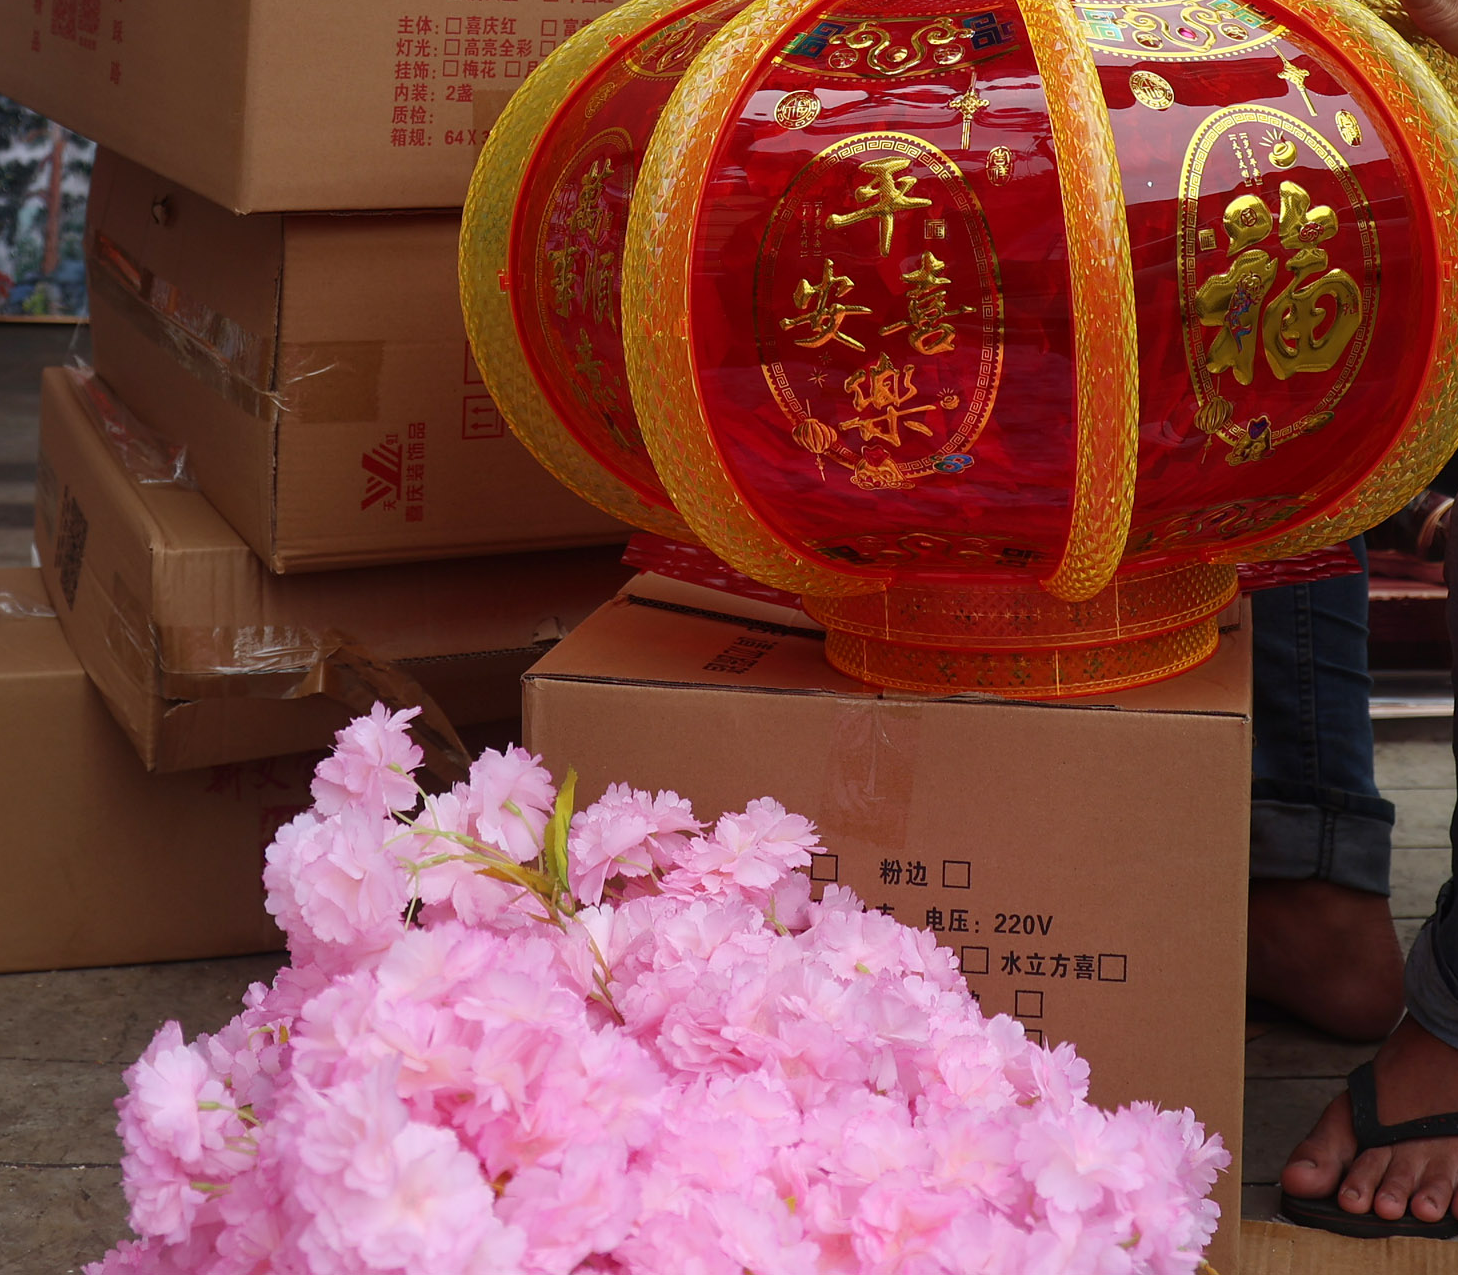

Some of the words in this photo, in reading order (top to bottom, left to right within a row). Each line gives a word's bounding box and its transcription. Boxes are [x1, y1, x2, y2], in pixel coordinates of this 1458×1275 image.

[465, 17, 517, 35] 喜庆红
[464, 39, 533, 58] 高亮全彩
[462, 60, 496, 79] 梅花
[825, 156, 932, 257] 平
[1195, 180, 1362, 385] 福
[779, 258, 873, 352] 安
[878, 251, 977, 355] 喜
[839, 352, 936, 447] 樂
[879, 858, 928, 887] 粉边
[994, 913, 1054, 936] 220V
[1001, 950, 1095, 981] 水立方喜
